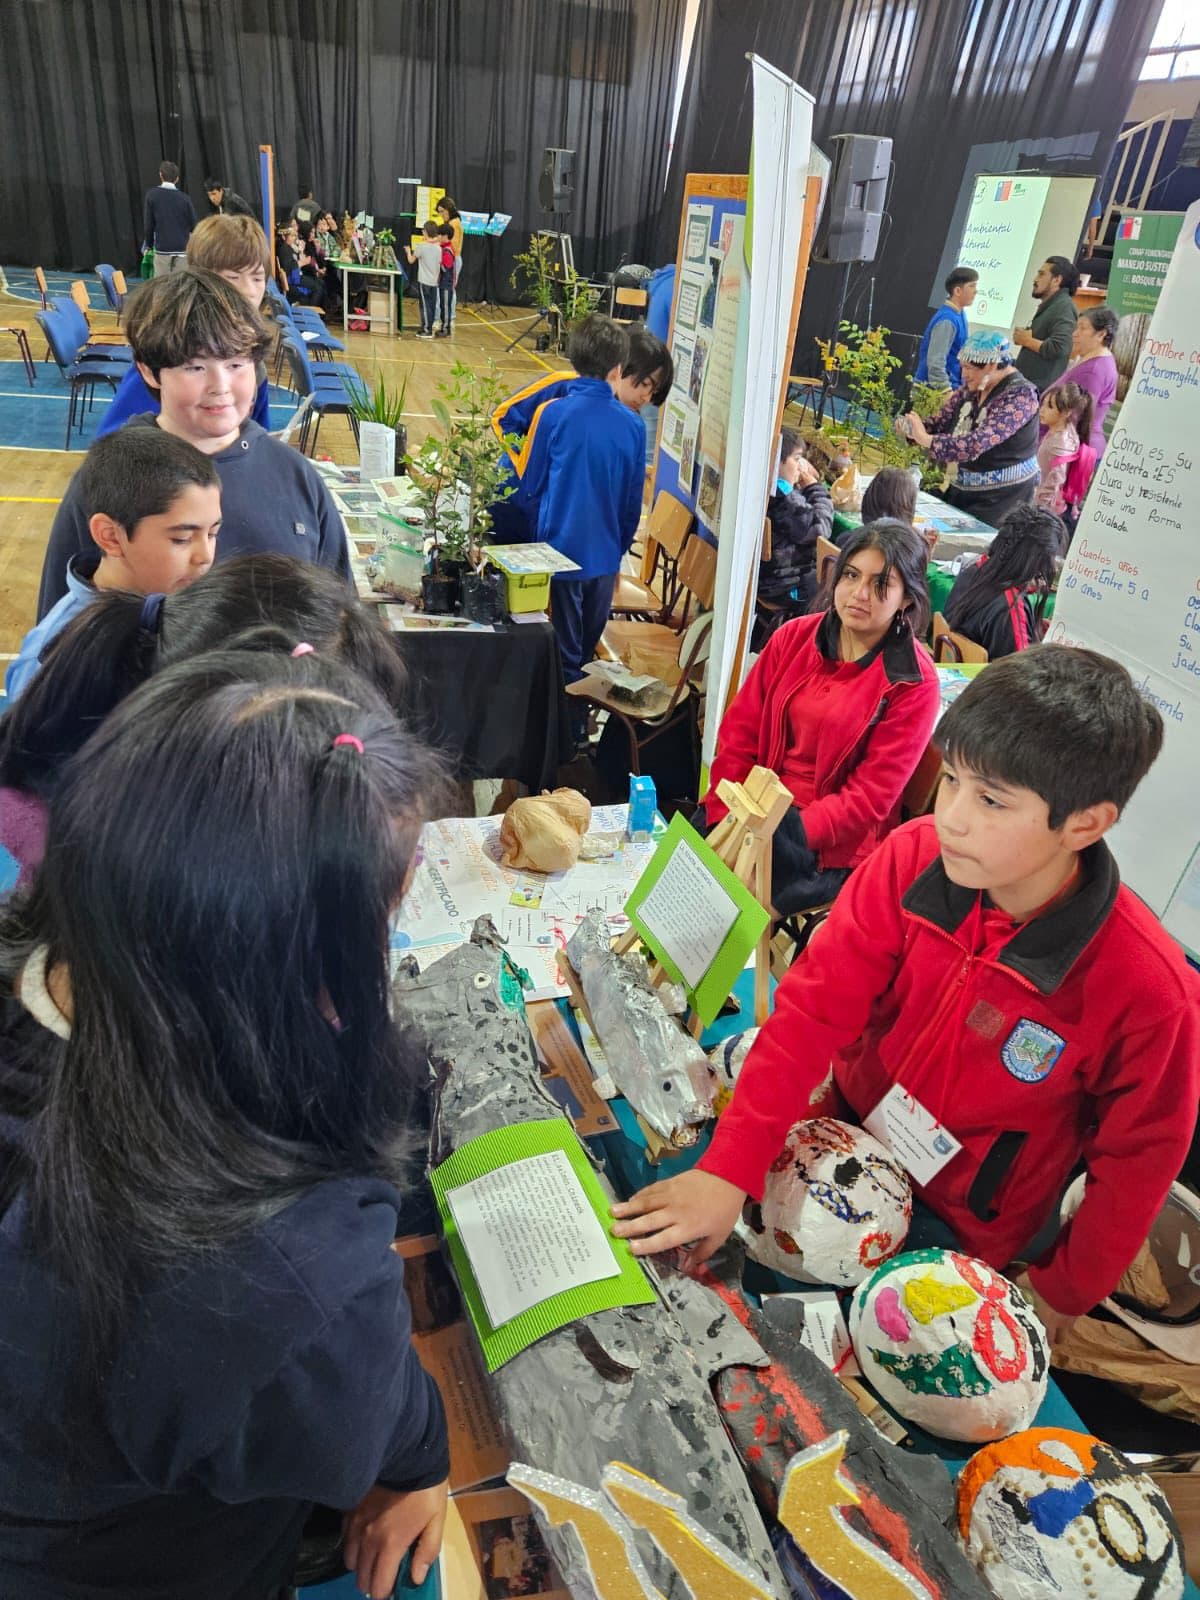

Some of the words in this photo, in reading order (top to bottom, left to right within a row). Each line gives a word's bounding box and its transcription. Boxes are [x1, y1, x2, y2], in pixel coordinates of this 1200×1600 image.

[1117, 258, 1144, 270] MANEJO
[1131, 275, 1156, 286] BOSQUE
[1112, 428, 1143, 455] Como
[1100, 469, 1122, 489] Dura
[1125, 484, 1135, 497] y
[1127, 580, 1137, 595] 5
[428, 867, 460, 919] CERTIFICADO
